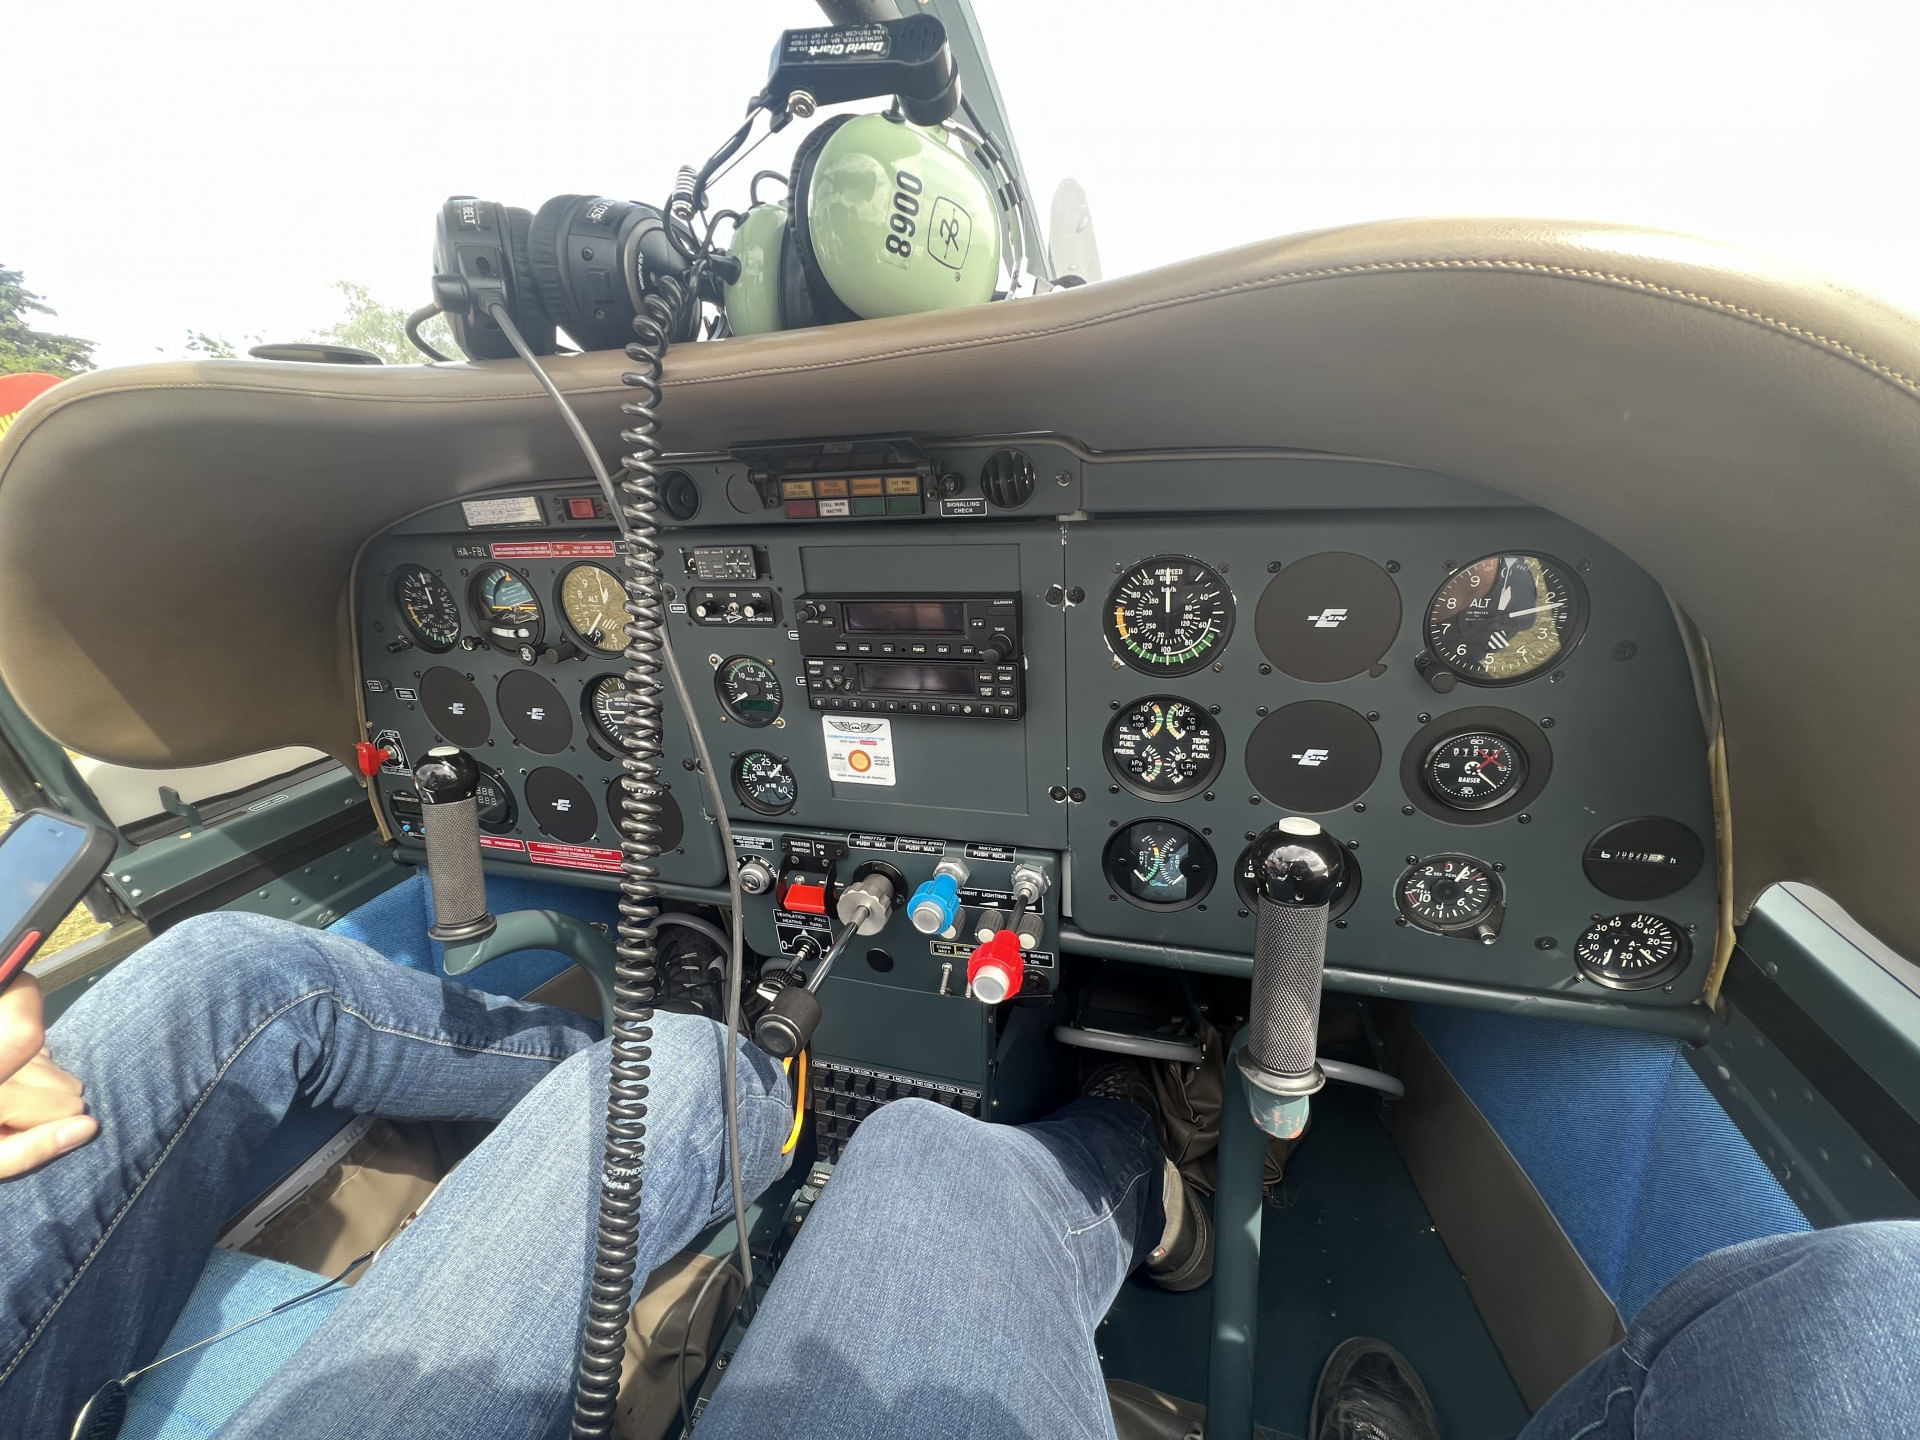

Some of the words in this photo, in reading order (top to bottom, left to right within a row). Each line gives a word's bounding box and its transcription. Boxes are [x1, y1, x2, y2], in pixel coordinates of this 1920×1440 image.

[808, 44, 845, 56] Clark
[845, 42, 884, 54] David
[456, 546, 487, 557] HA-FBL
[1470, 575, 1481, 587] 9
[1545, 592, 1556, 604] 2
[1446, 597, 1457, 609] 8
[1469, 598, 1492, 608] ALT
[1441, 623, 1451, 635] 7
[1538, 628, 1548, 639] 3
[1456, 644, 1467, 655] 6
[1516, 645, 1527, 655] 4
[1484, 653, 1495, 665] 5
[761, 758, 771, 766] 25
[751, 763, 762, 771] 20
[749, 773, 758, 781] 15
[1458, 776, 1480, 784] BAUSER
[757, 784, 765, 792] 10
[778, 786, 788, 794] 40
[1460, 787, 1474, 795] 30
[1416, 880, 1424, 889] 4
[1464, 885, 1473, 894] 4
[1419, 893, 1431, 902] 10
[1457, 898, 1465, 906] 6
[776, 912, 806, 920] VENTILATION
